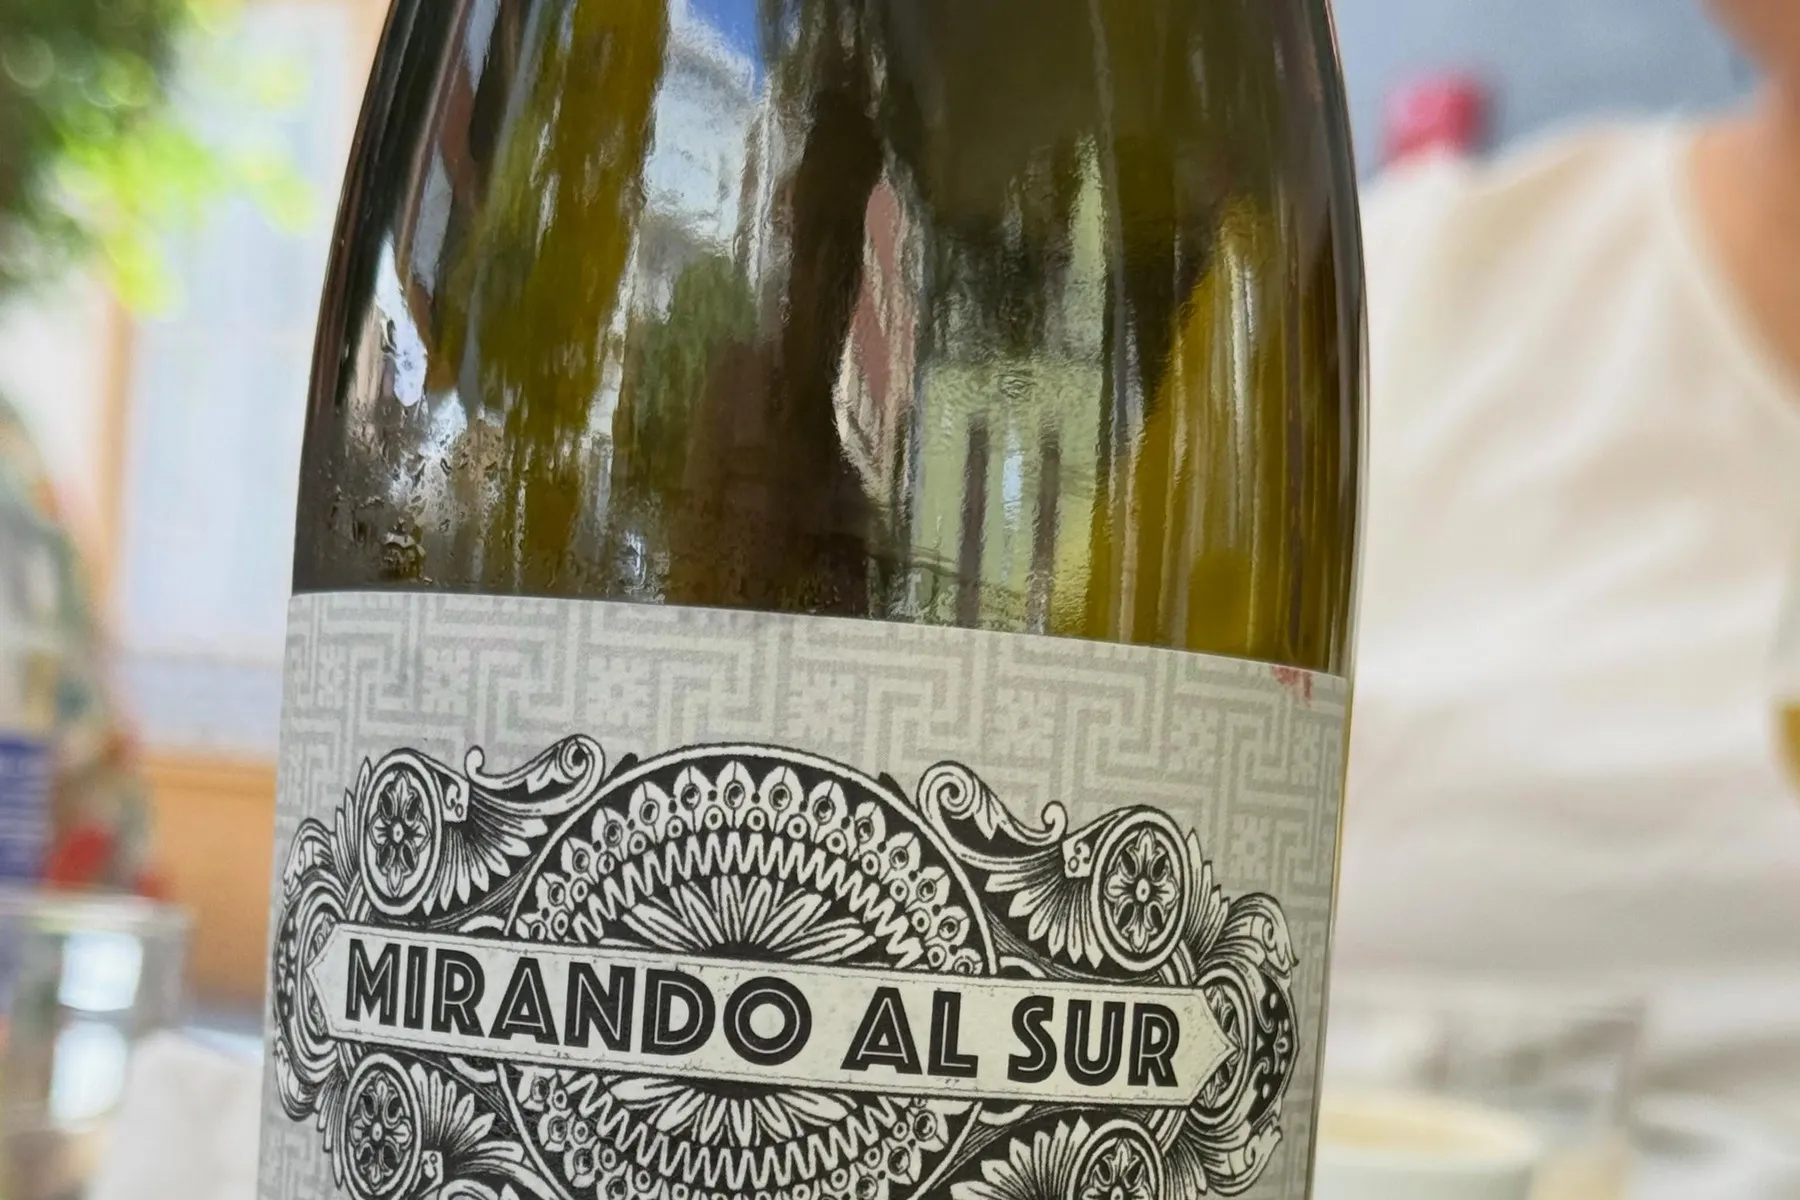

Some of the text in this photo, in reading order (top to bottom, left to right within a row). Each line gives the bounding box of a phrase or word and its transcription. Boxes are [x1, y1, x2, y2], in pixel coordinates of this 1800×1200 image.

[344, 938, 1179, 1088] MIRANDO AL SUR
